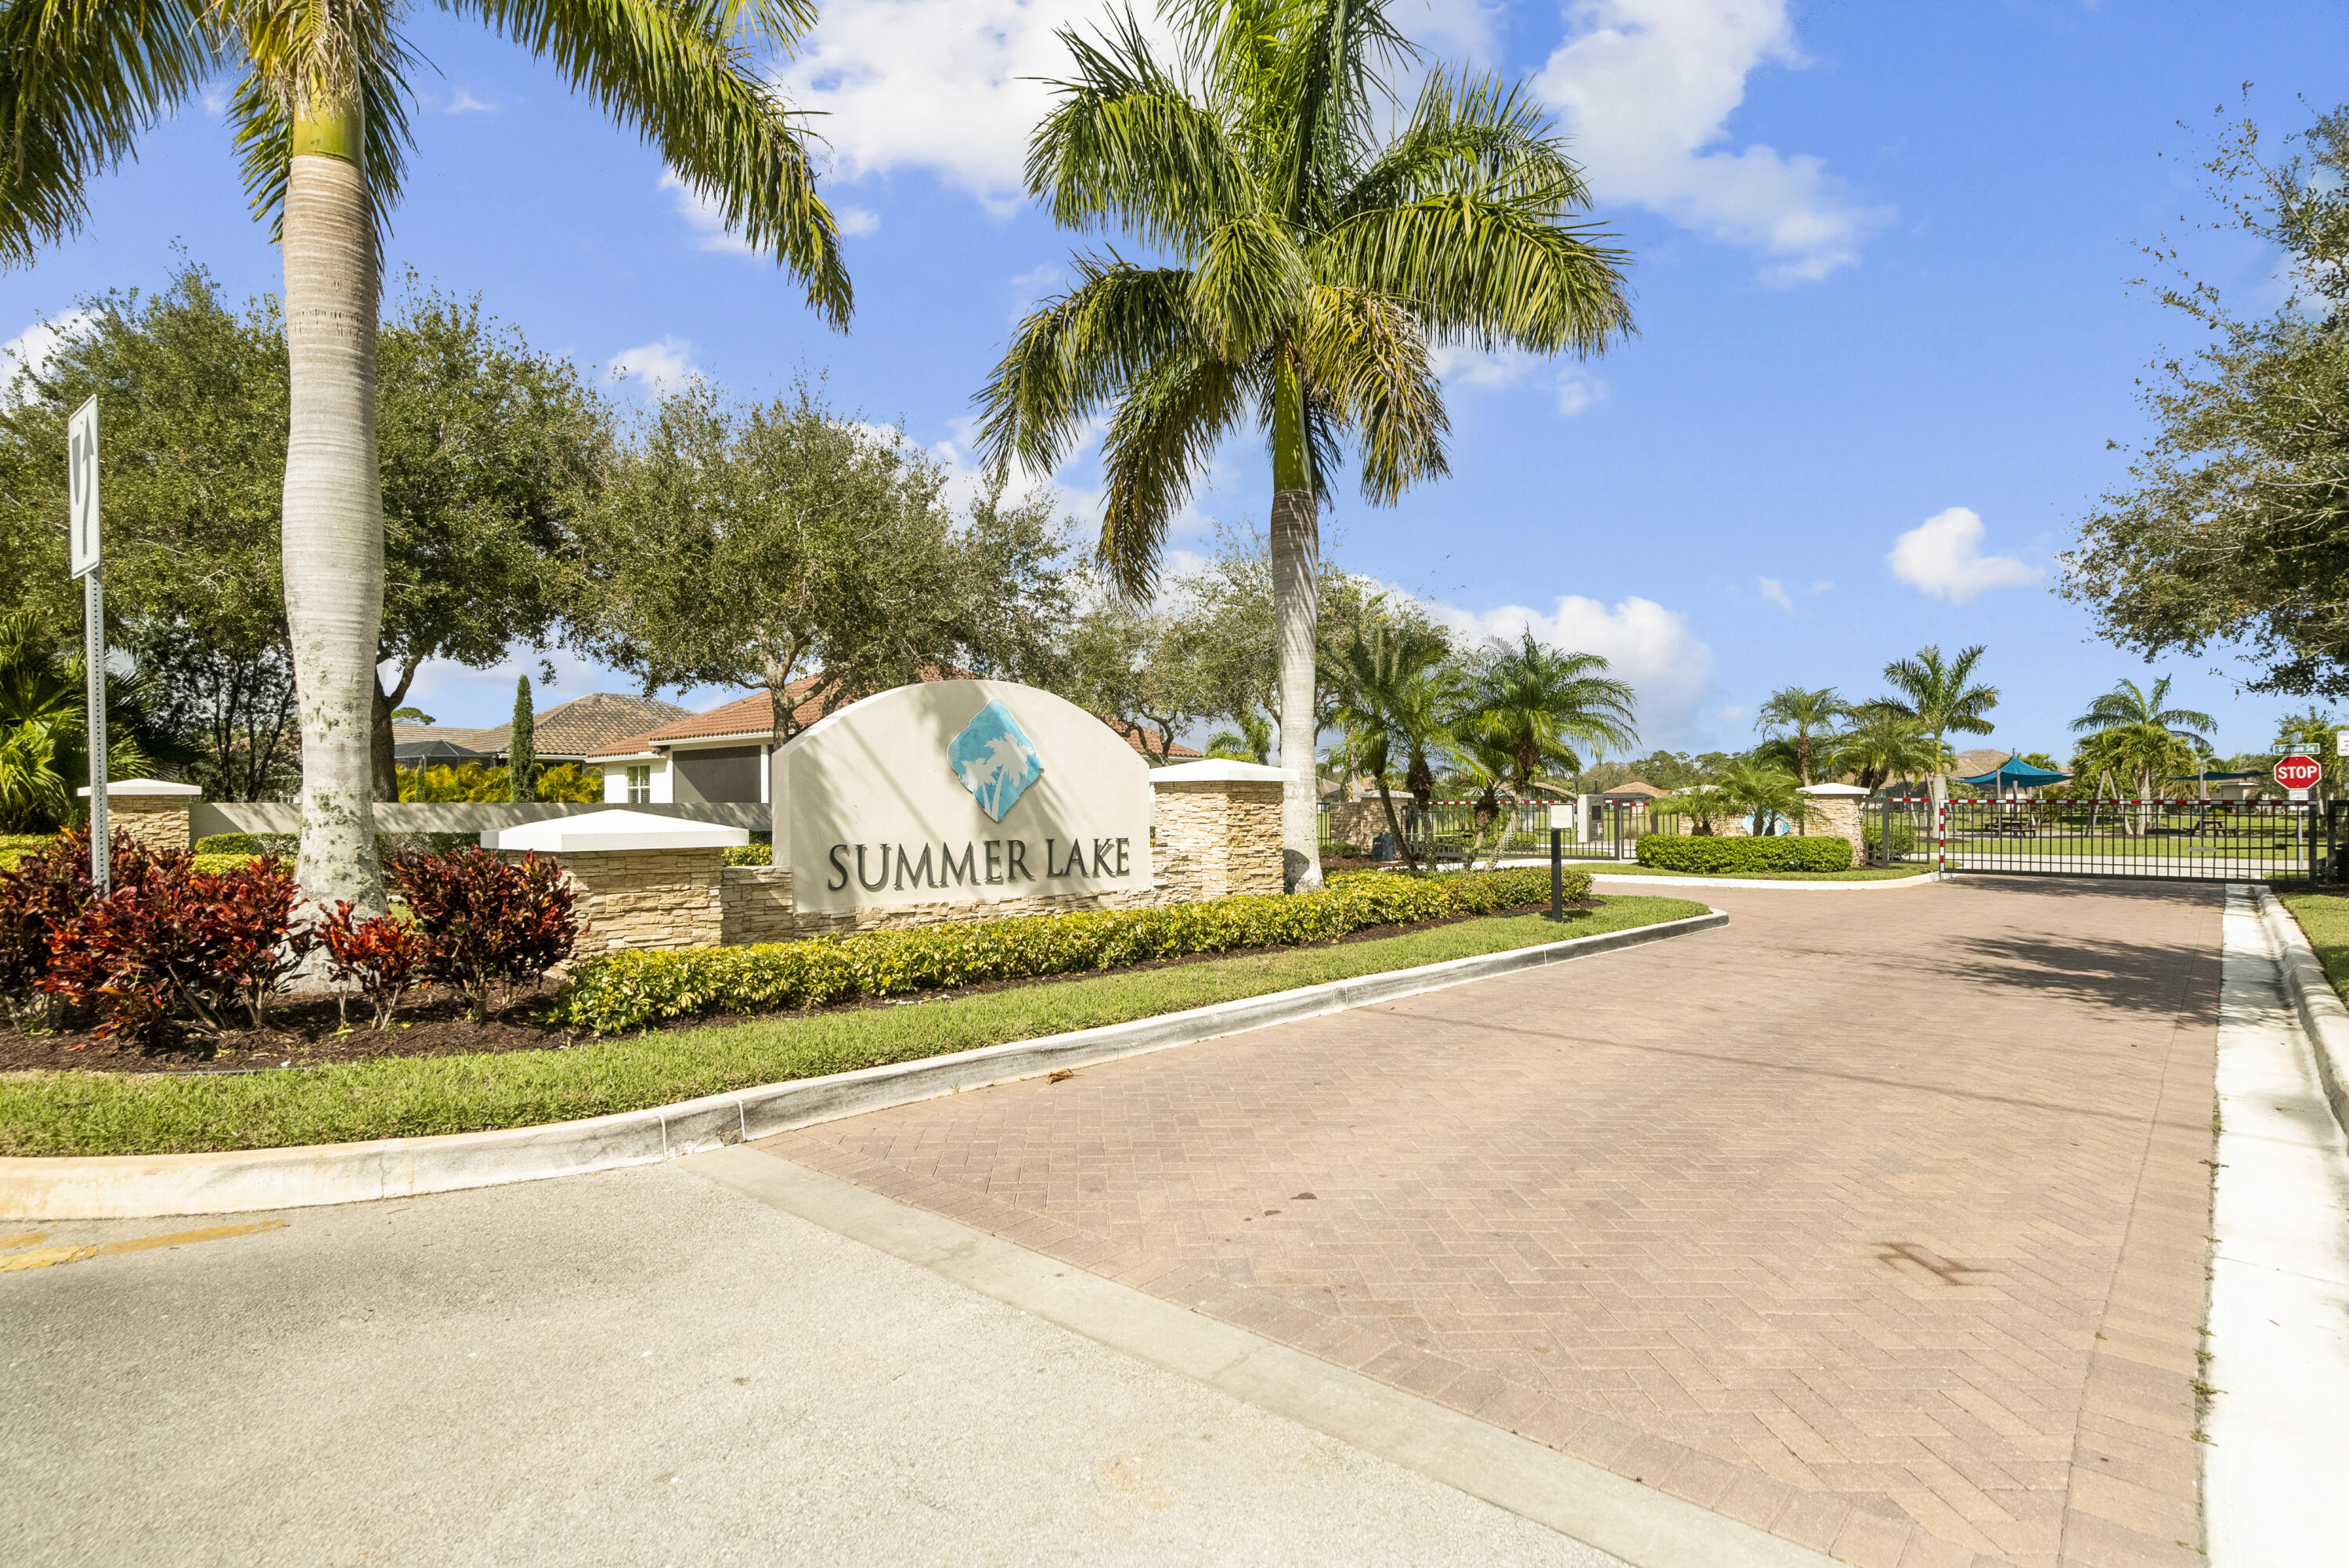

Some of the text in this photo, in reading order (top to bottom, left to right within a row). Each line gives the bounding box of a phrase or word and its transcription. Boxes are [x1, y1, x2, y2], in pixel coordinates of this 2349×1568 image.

[2305, 744, 2315, 753] Sq
[2278, 766, 2318, 780] STOP
[827, 837, 1131, 892] SUMMER LAKE
